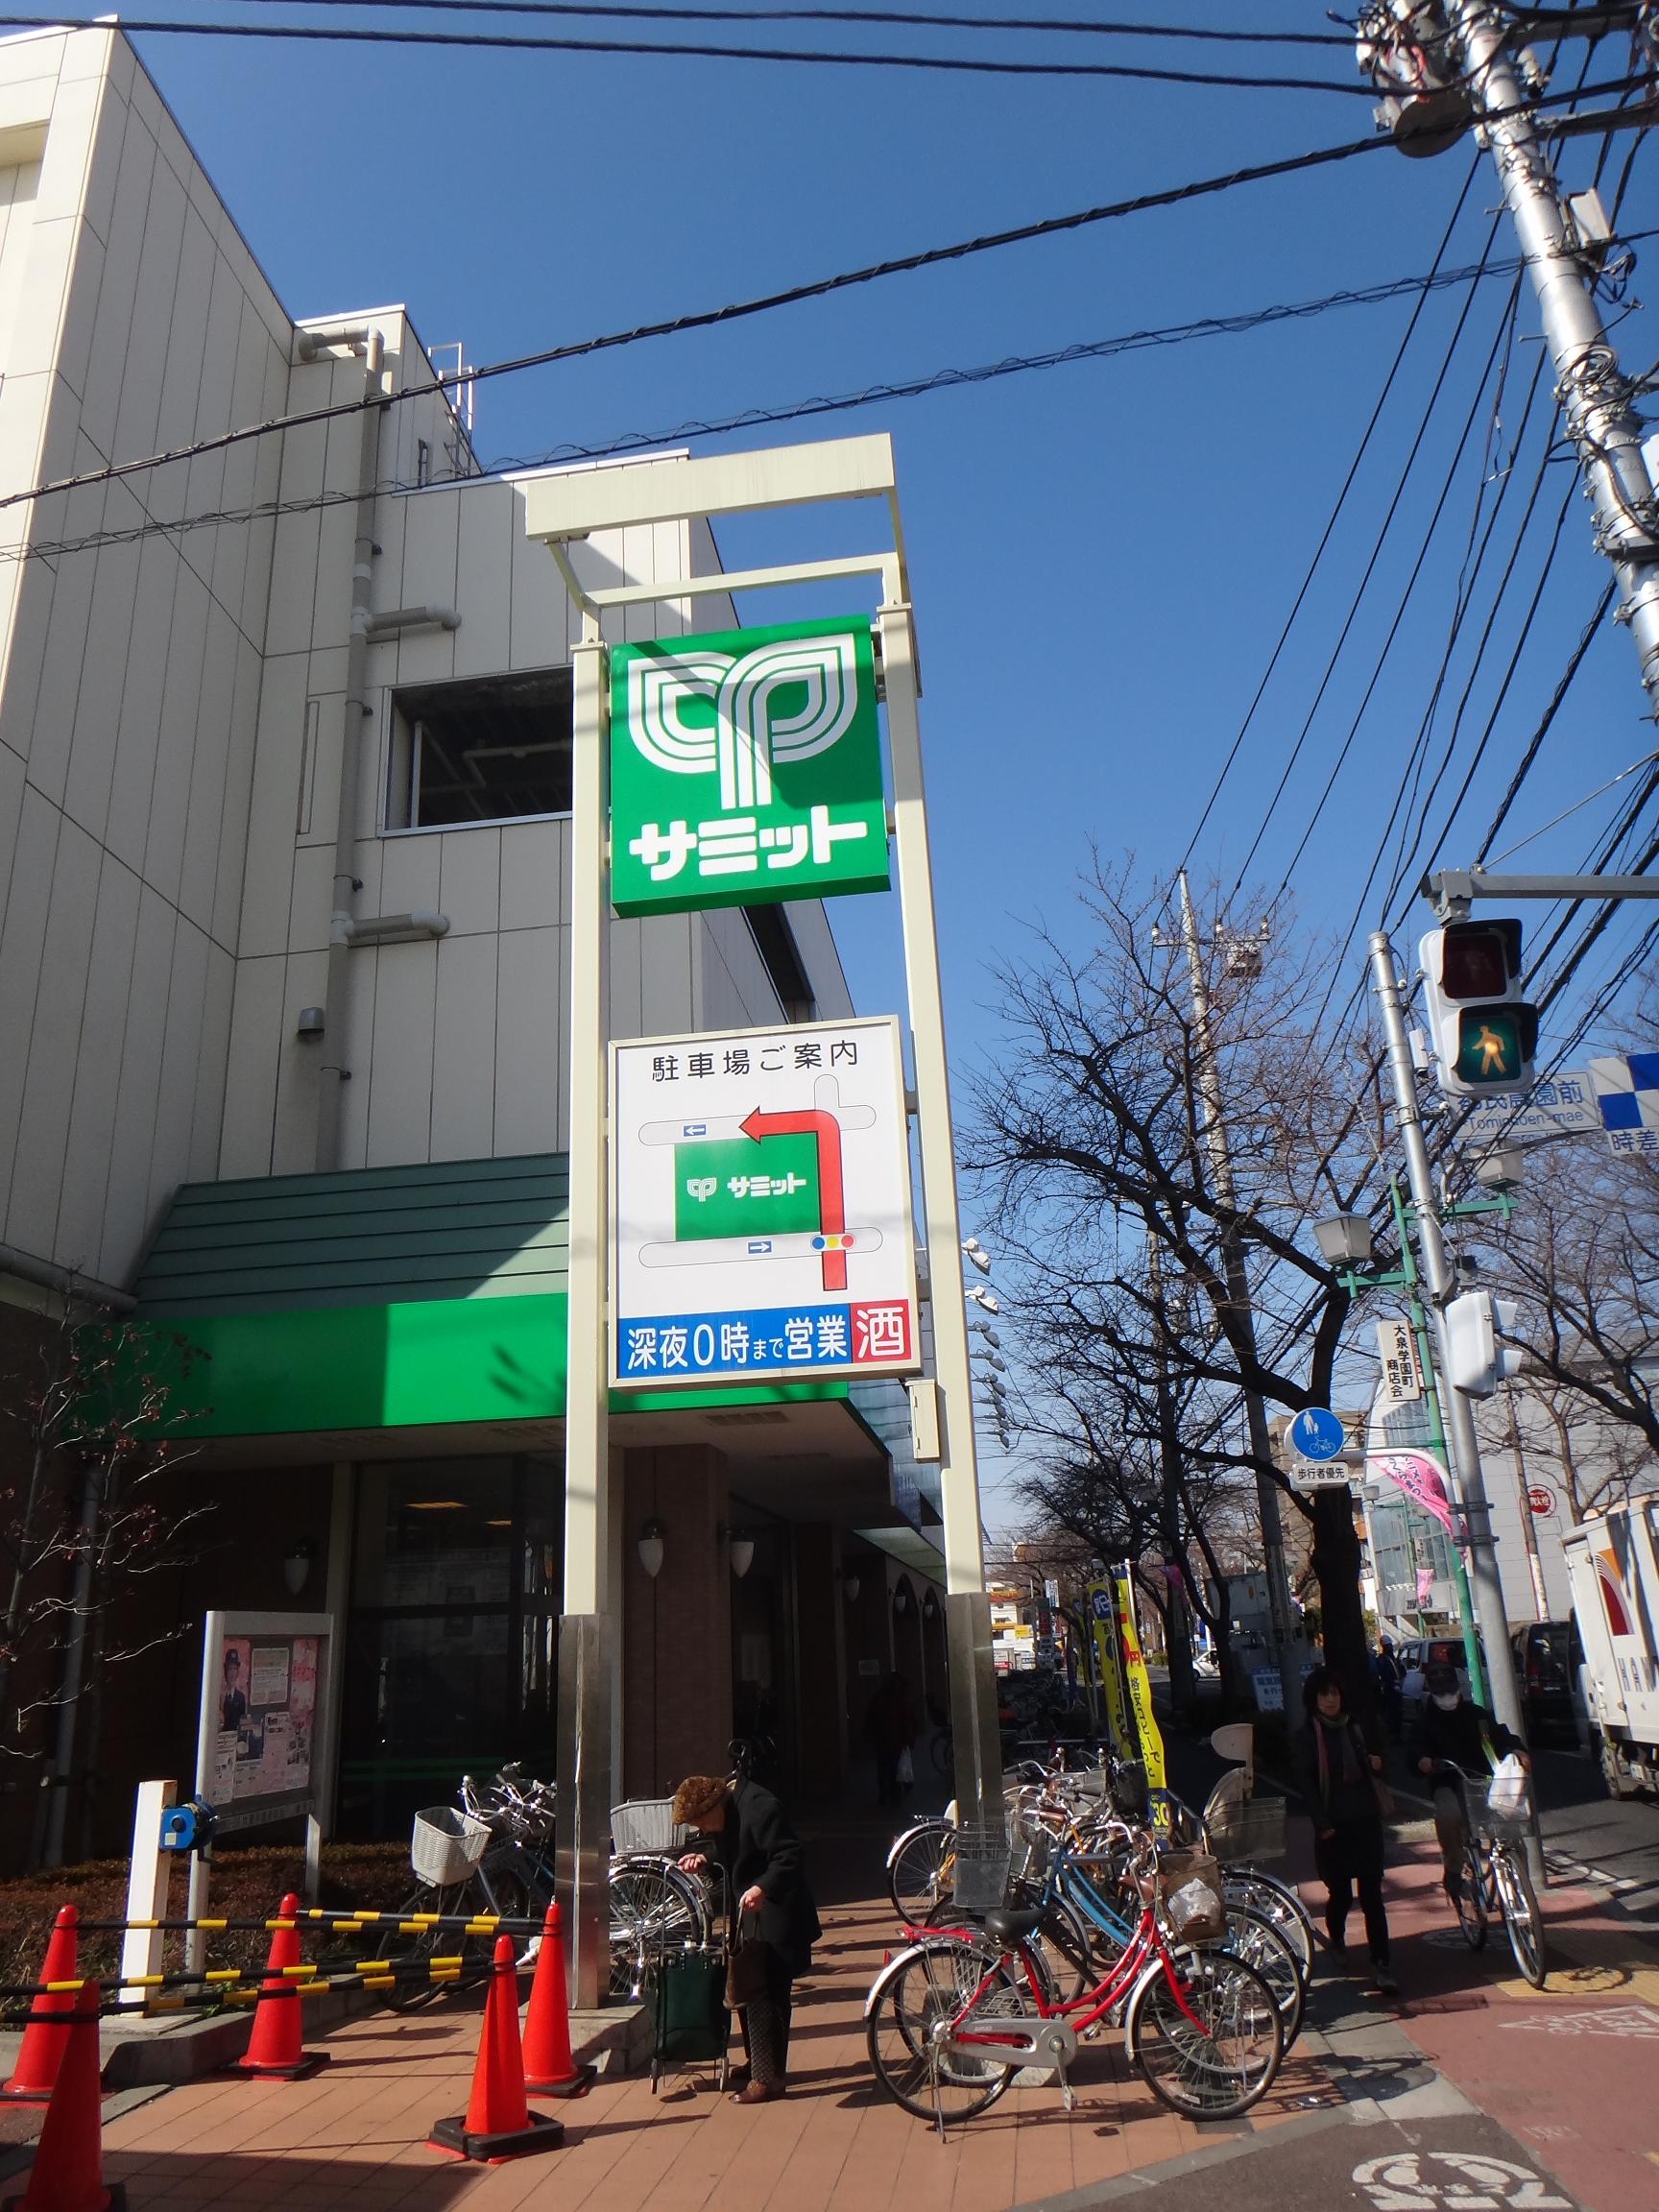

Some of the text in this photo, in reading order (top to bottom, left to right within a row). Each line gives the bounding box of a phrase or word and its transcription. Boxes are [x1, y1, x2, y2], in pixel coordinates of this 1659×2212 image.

[629, 805, 868, 881] サミット
[652, 1040, 858, 1083] 駐車場ご案内
[727, 1171, 806, 1199] サミット
[627, 1315, 848, 1371] 深夜0時まで営業
[855, 1306, 905, 1360] 酒
[1393, 1324, 1414, 1388] 大泉学園町
[1386, 1358, 1404, 1398] 商店会
[1297, 1467, 1345, 1480] 歩行者優先
